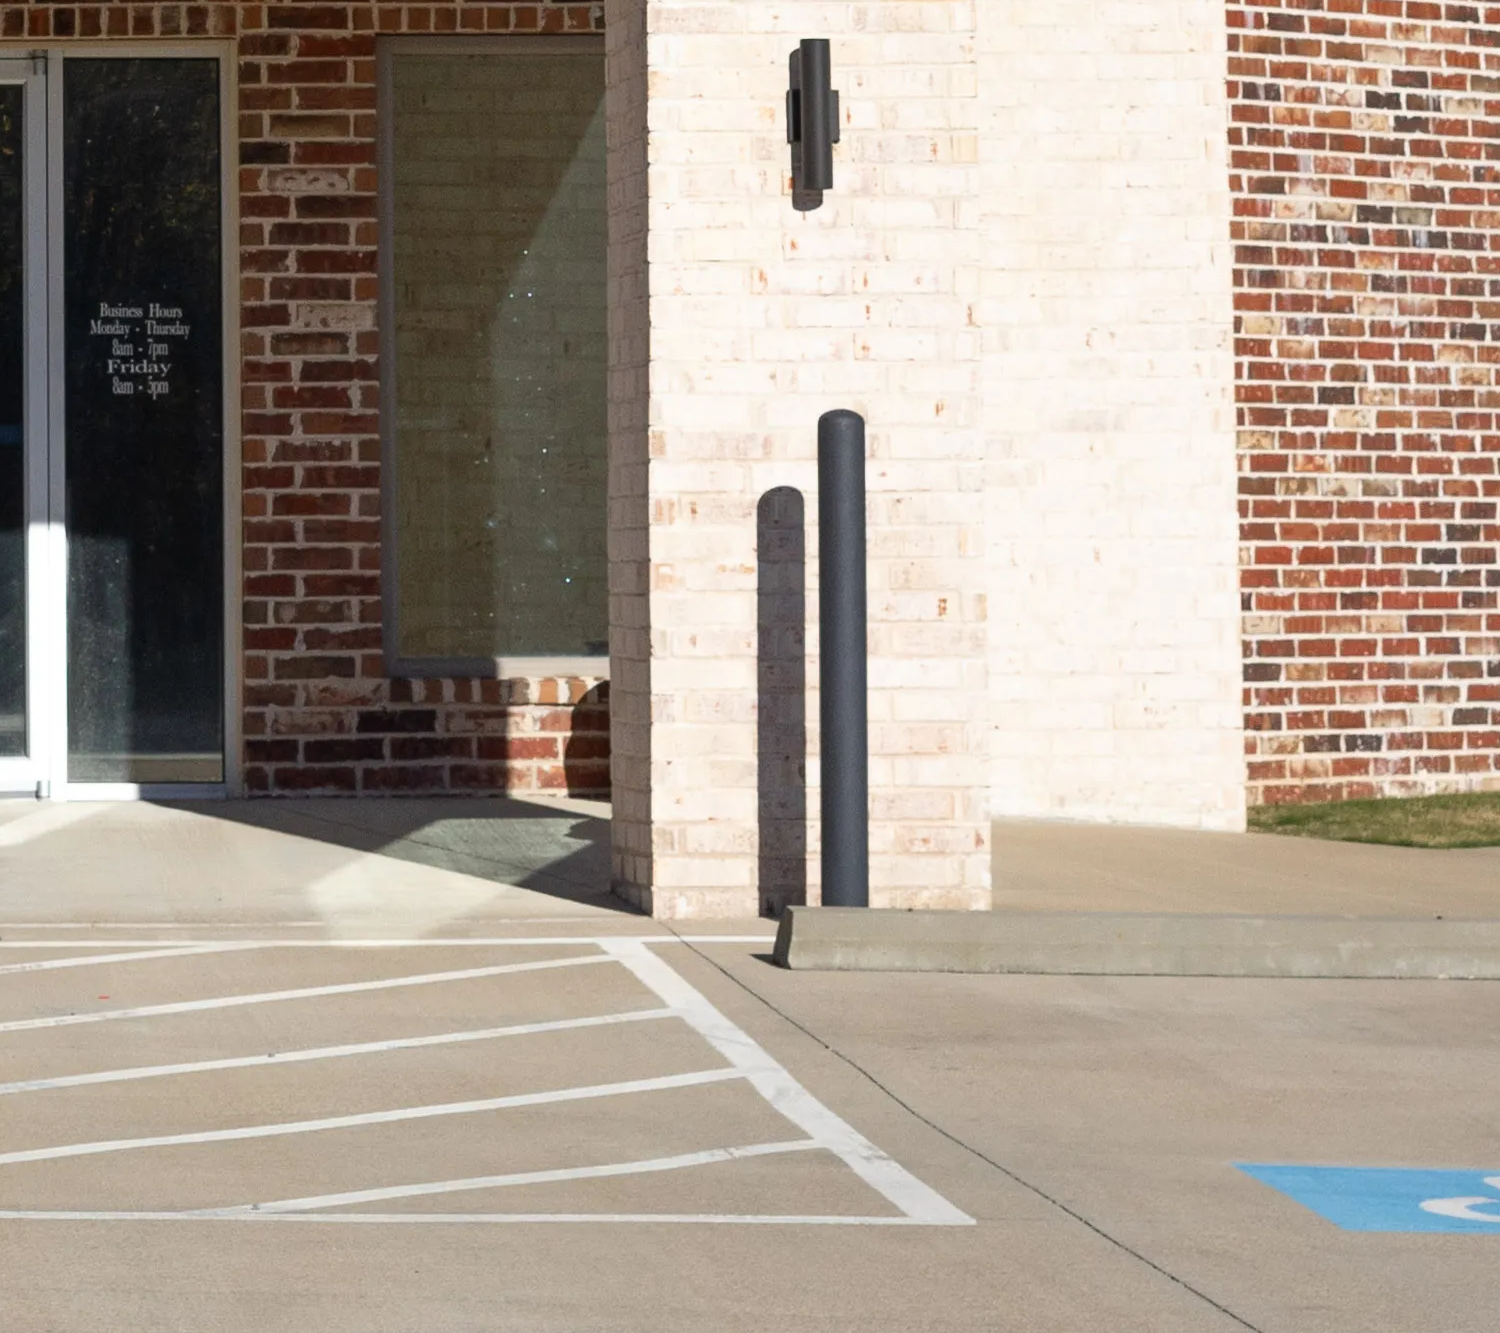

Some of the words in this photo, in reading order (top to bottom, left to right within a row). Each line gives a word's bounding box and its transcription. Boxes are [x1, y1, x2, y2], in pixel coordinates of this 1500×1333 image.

[100, 302, 143, 318] Business
[149, 303, 183, 318] Hours
[90, 319, 131, 339] Monday
[145, 319, 190, 340] Thursday
[112, 338, 133, 356] 8am
[147, 338, 168, 361] 7pm
[107, 359, 172, 377] Friday
[112, 376, 133, 394] 8am
[147, 376, 169, 400] 5pm
